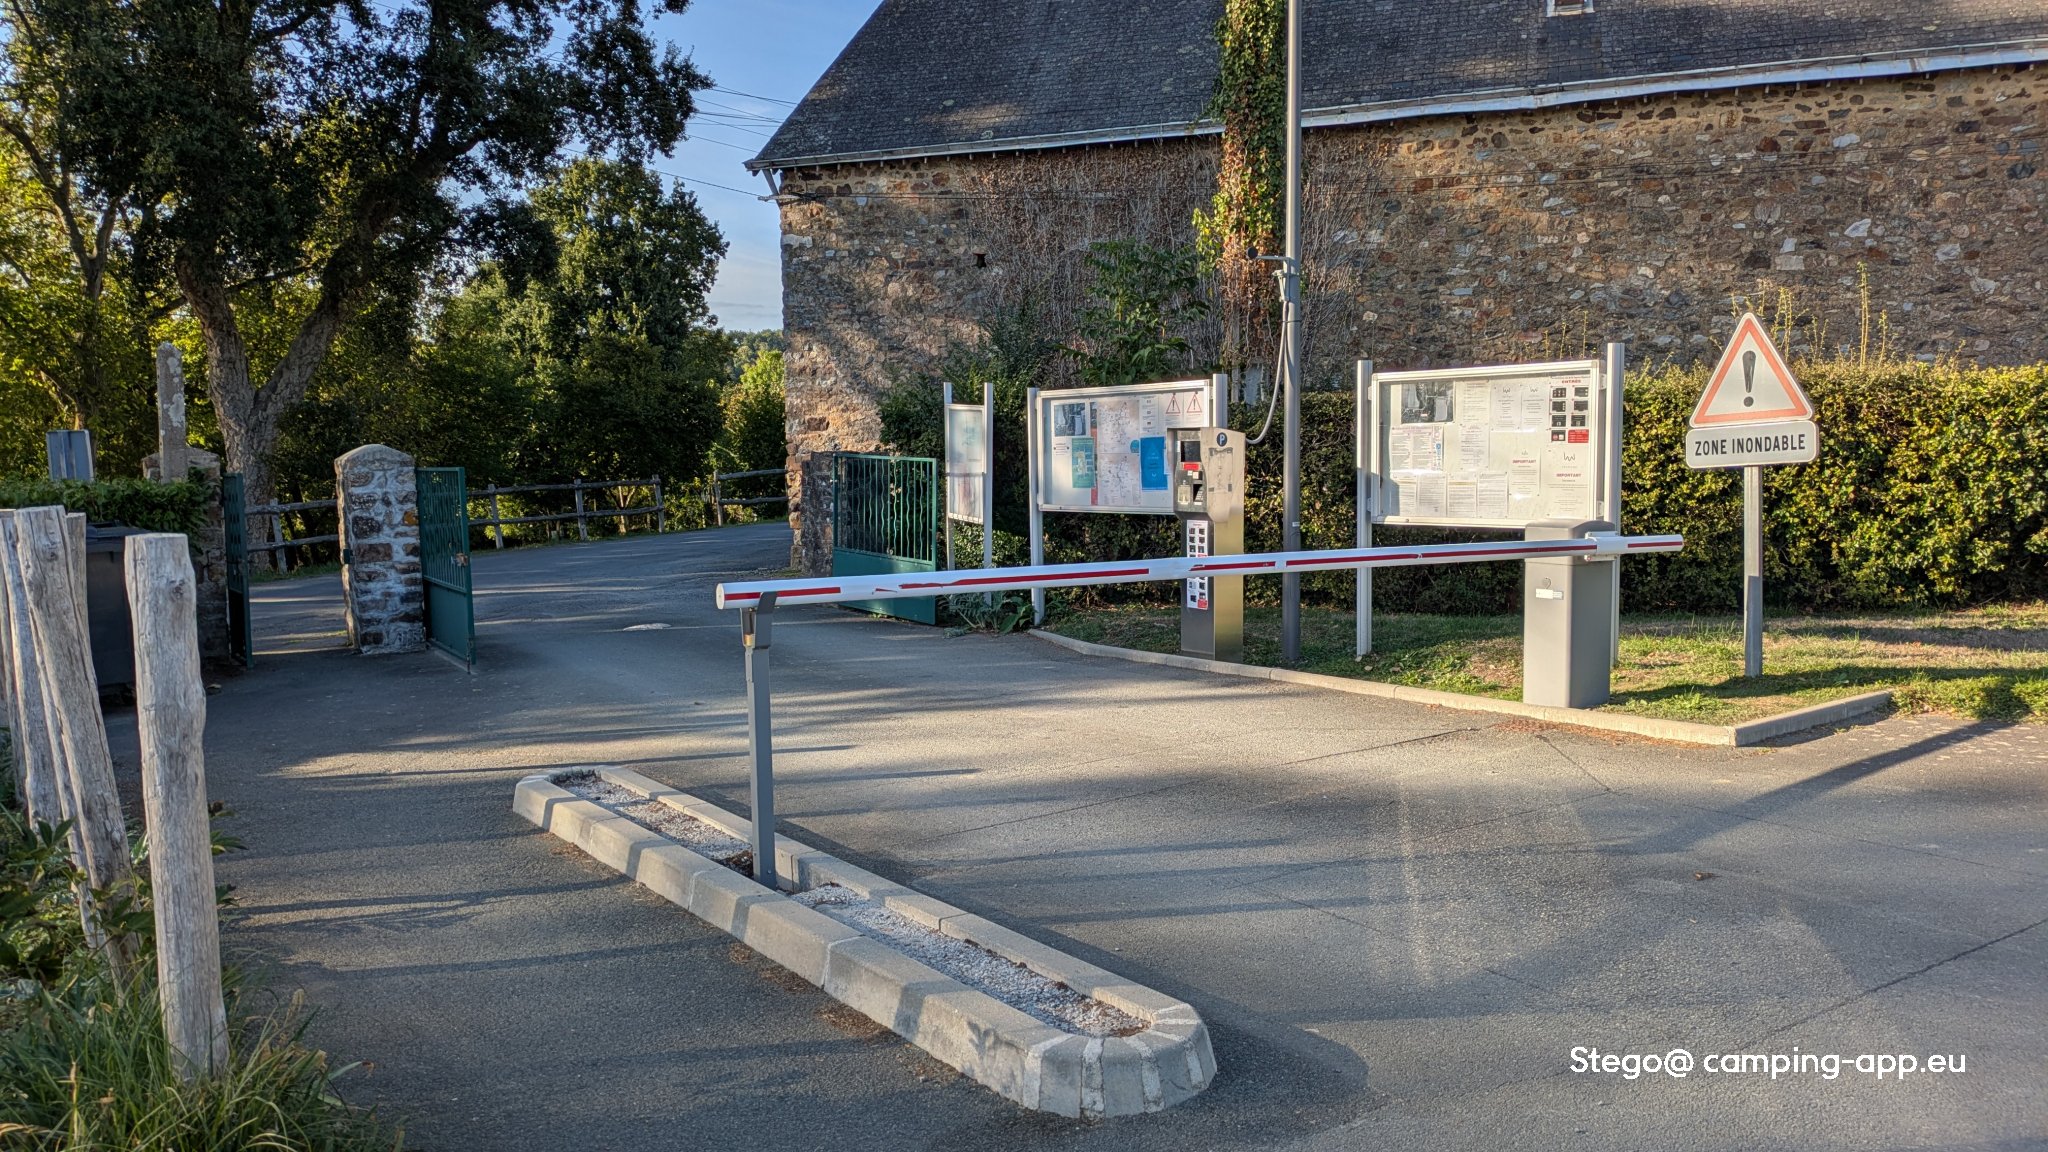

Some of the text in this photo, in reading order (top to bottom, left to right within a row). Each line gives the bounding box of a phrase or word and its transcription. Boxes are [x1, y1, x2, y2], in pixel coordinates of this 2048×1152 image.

[1219, 434, 1226, 446] P
[1695, 433, 1806, 456] ZONE INONDABLE
